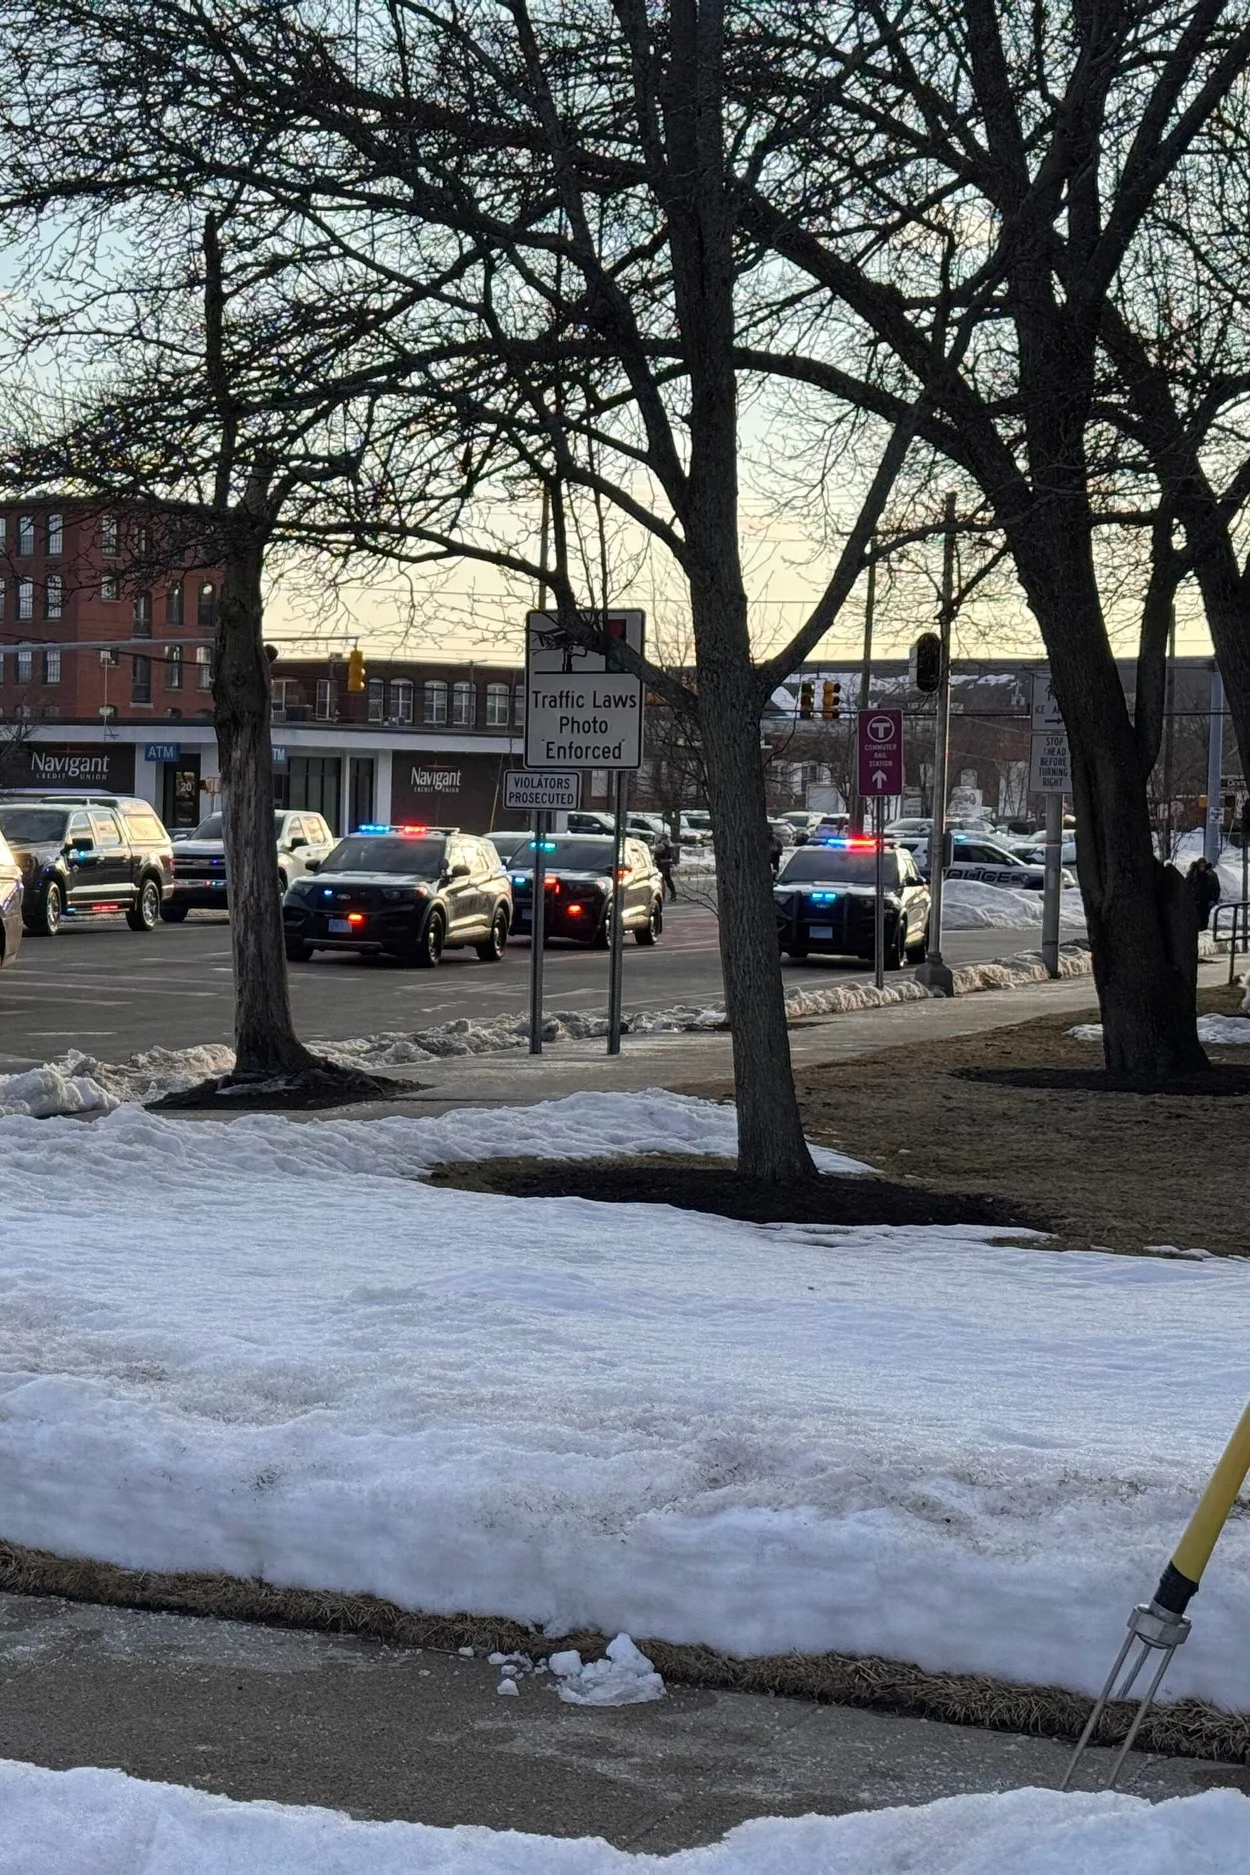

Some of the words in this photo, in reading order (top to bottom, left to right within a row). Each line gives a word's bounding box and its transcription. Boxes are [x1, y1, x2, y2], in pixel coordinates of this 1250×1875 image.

[532, 690, 585, 709] Traffic
[592, 690, 638, 709] Laws
[559, 715, 609, 734] Photo
[864, 743, 897, 751] COMMUTER
[1045, 736, 1065, 747] STOP
[148, 745, 174, 759] ATM
[873, 751, 888, 759] RAIL
[30, 751, 110, 777] Navigant
[1039, 756, 1067, 767] BEFORE
[36, 772, 67, 780] CREDIT
[410, 766, 462, 791] Navigant
[513, 775, 571, 790] VIOLATORS
[508, 791, 575, 805] PROSECUTED
